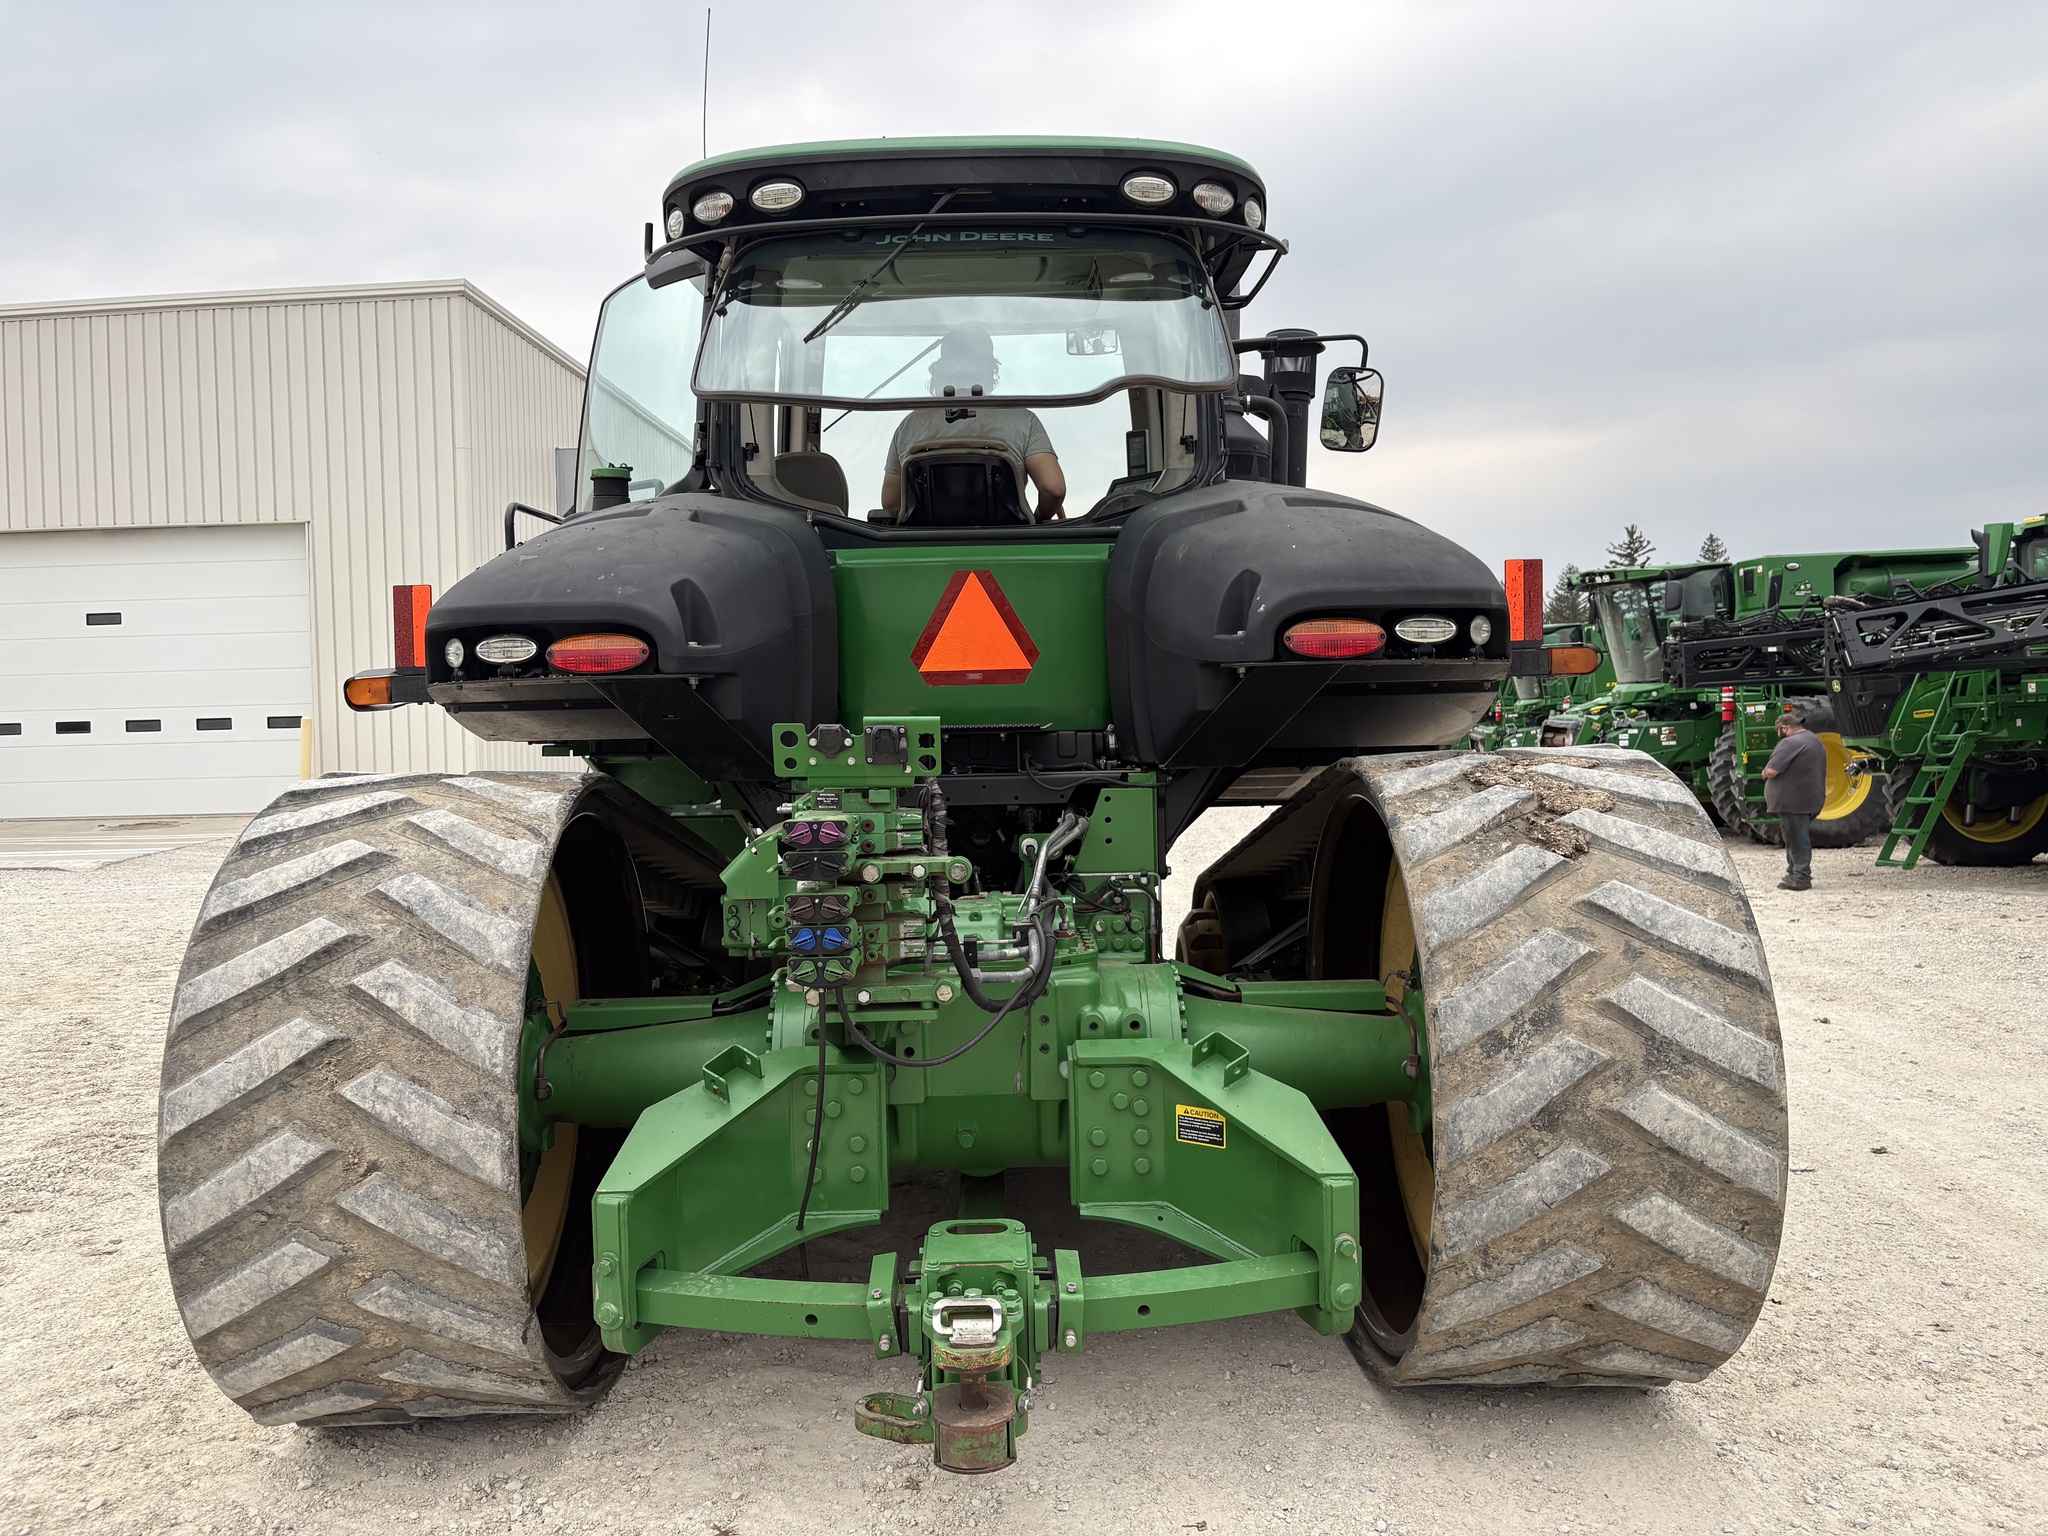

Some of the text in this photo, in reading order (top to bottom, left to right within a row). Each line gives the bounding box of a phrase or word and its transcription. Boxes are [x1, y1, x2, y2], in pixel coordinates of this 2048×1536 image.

[876, 231, 1054, 245] JOHN DEERE
[1189, 1109, 1219, 1120] CAUTION
